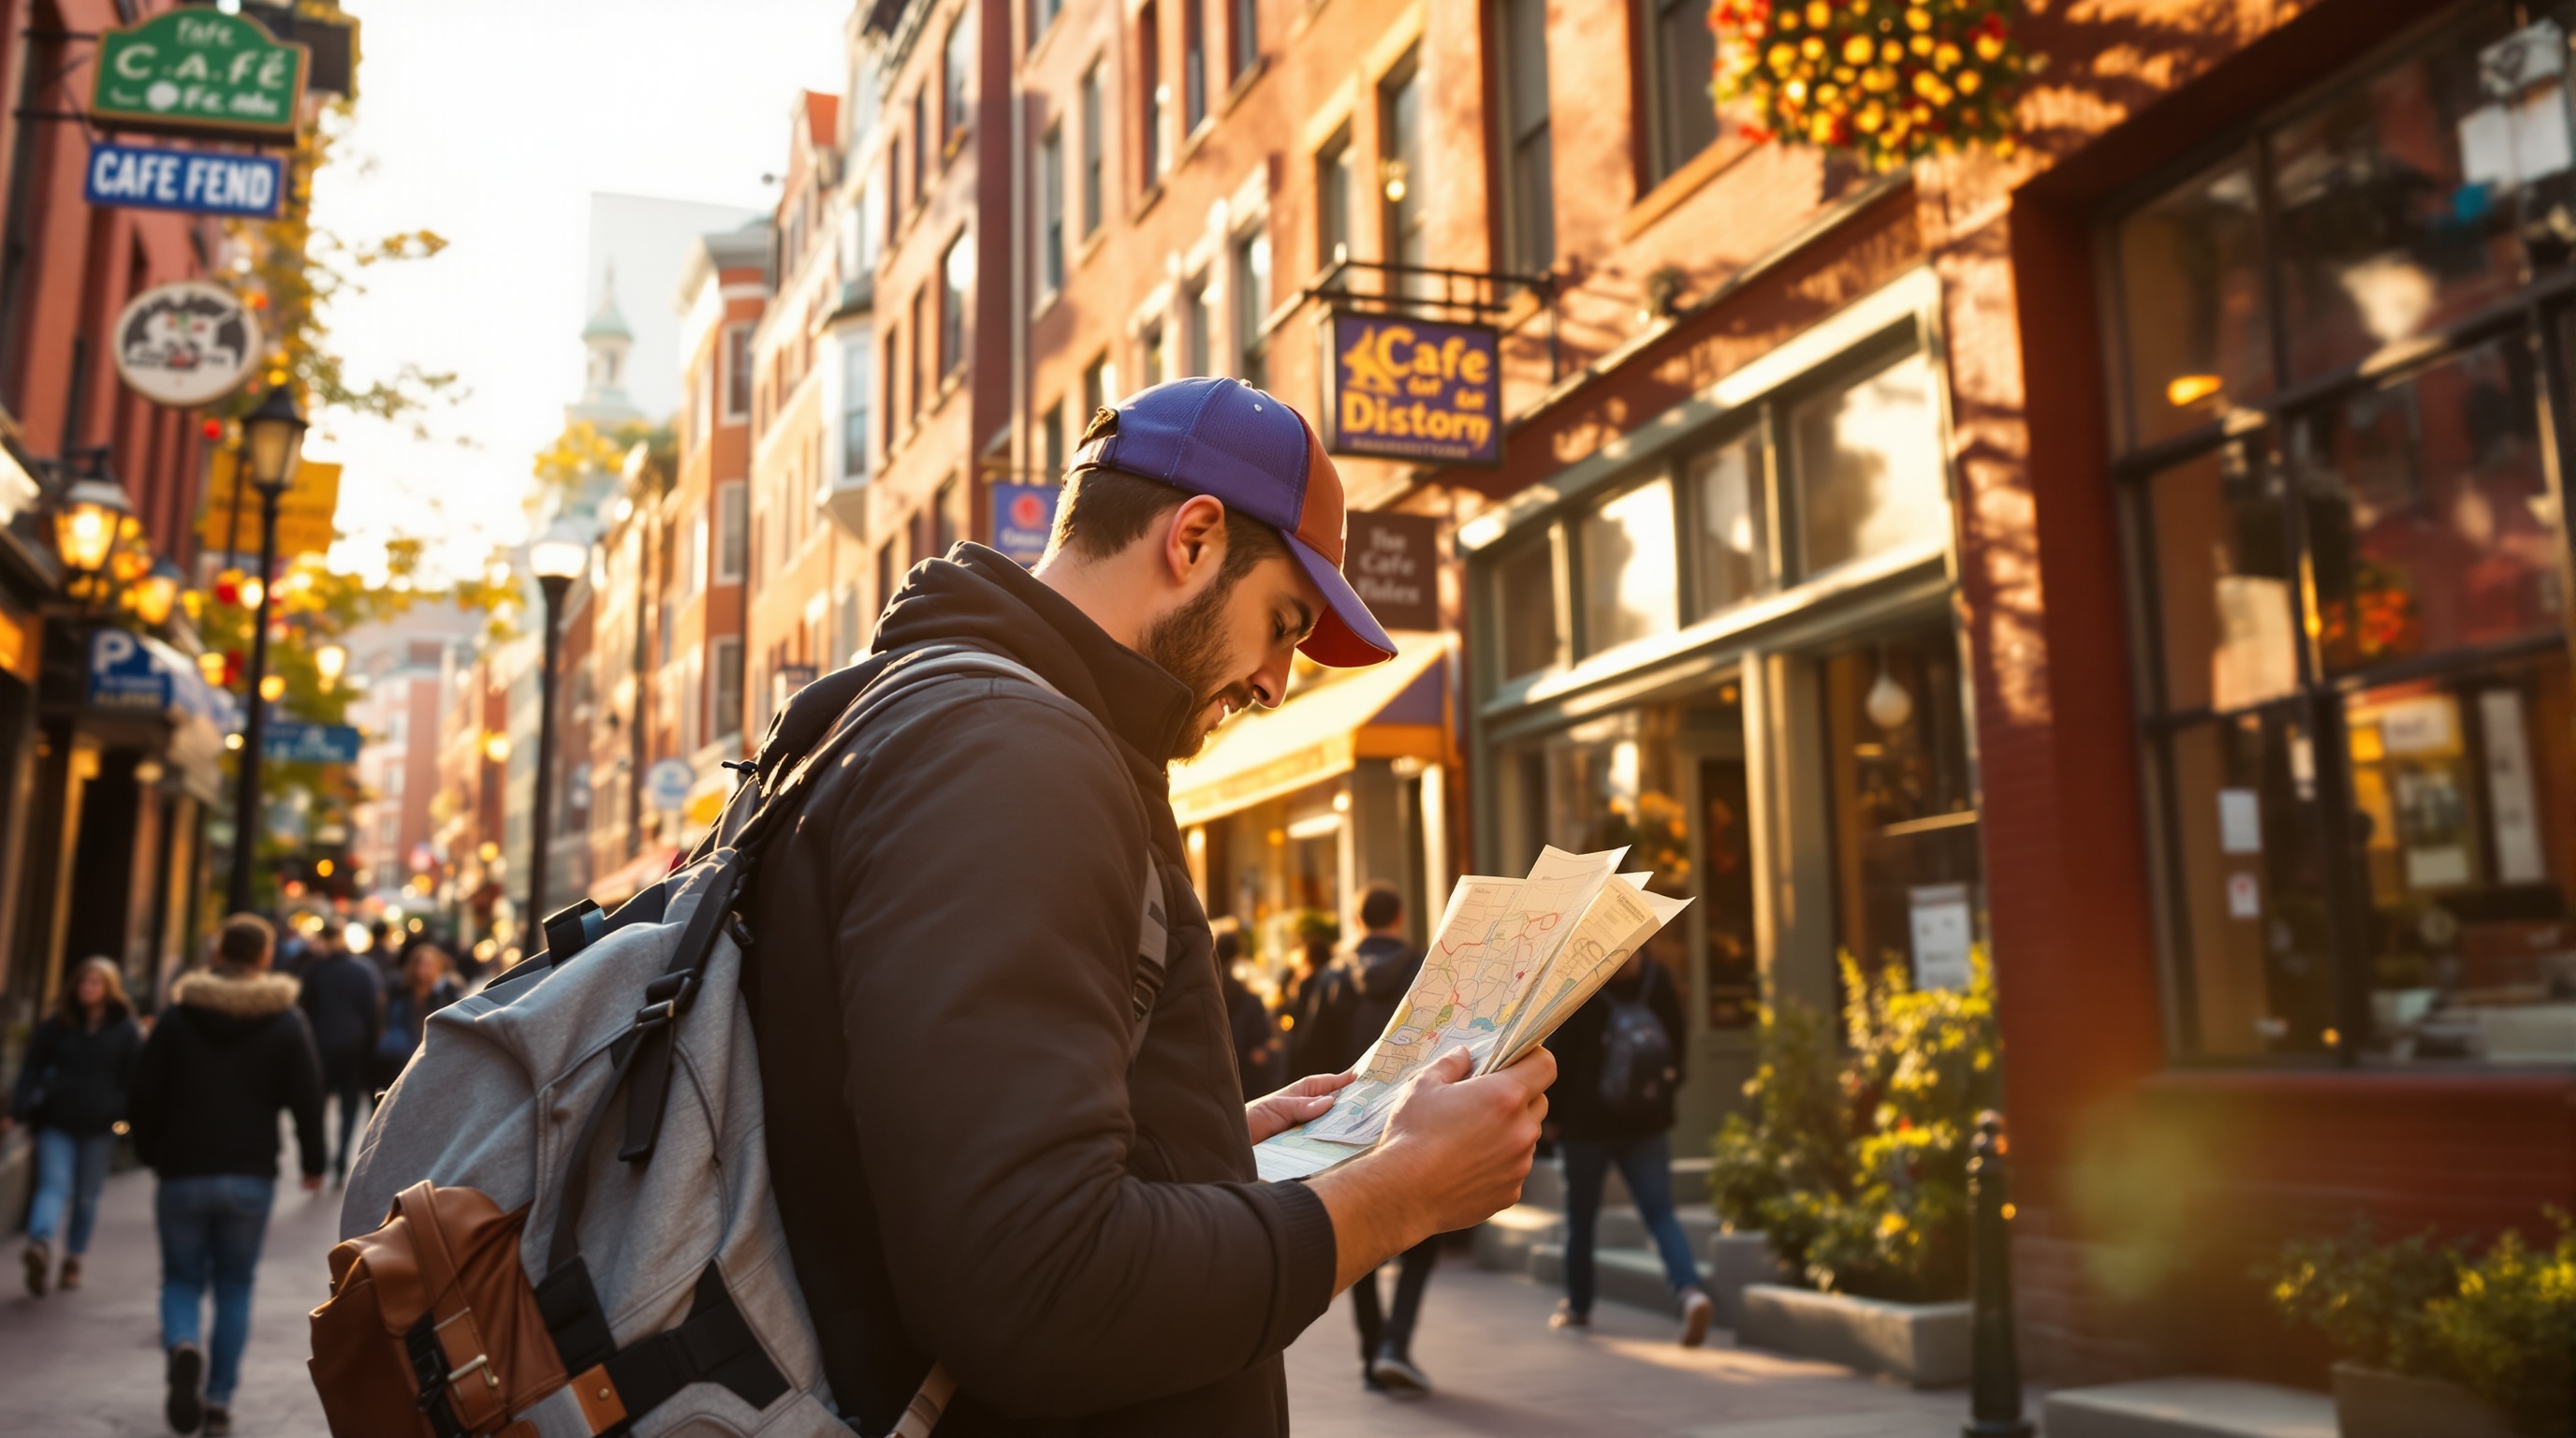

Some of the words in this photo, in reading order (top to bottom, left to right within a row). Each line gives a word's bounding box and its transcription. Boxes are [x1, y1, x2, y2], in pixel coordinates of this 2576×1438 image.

[95, 150, 181, 201] CAFE
[185, 157, 273, 209] FEND
[1375, 324, 1491, 386] Cafe
[94, 629, 135, 673] P
